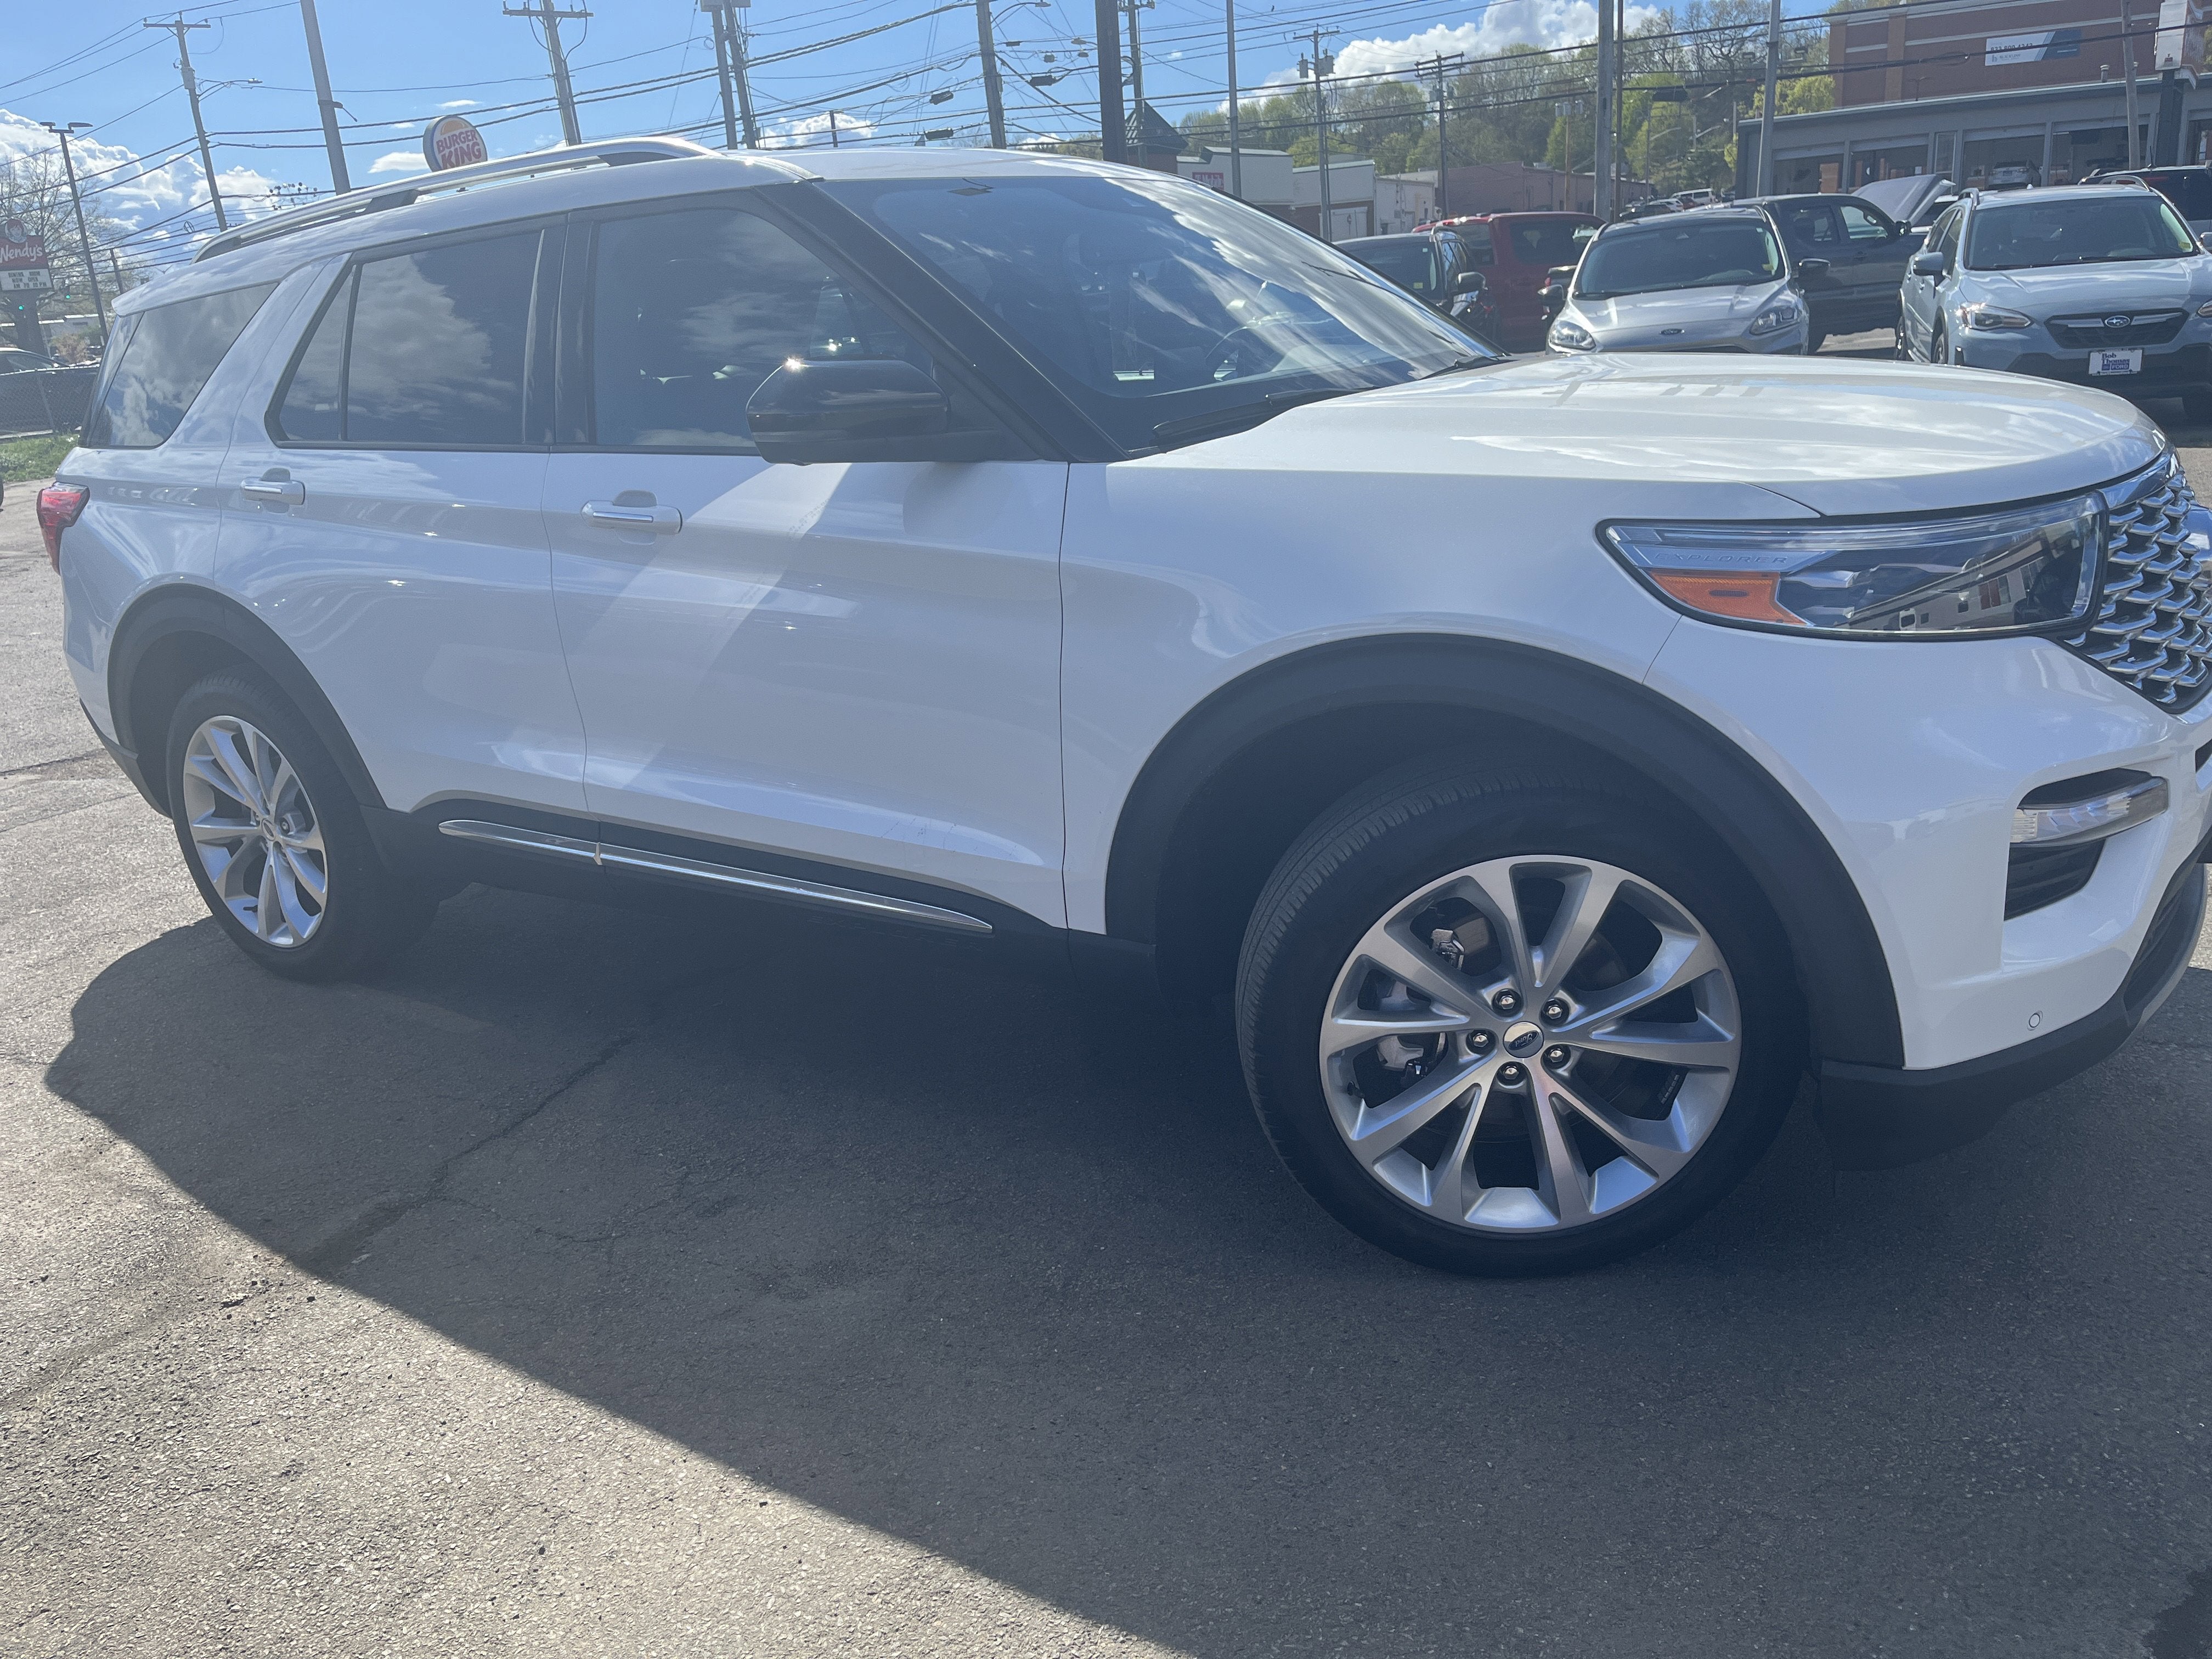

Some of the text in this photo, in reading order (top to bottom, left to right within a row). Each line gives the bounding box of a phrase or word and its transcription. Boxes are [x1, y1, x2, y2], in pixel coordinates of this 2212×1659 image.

[436, 129, 477, 154] BURGER
[441, 142, 482, 170] KING
[0, 242, 43, 263] Wendy's
[1654, 552, 1787, 563] EXPLORER
[1515, 1033, 1533, 1047] Ford
